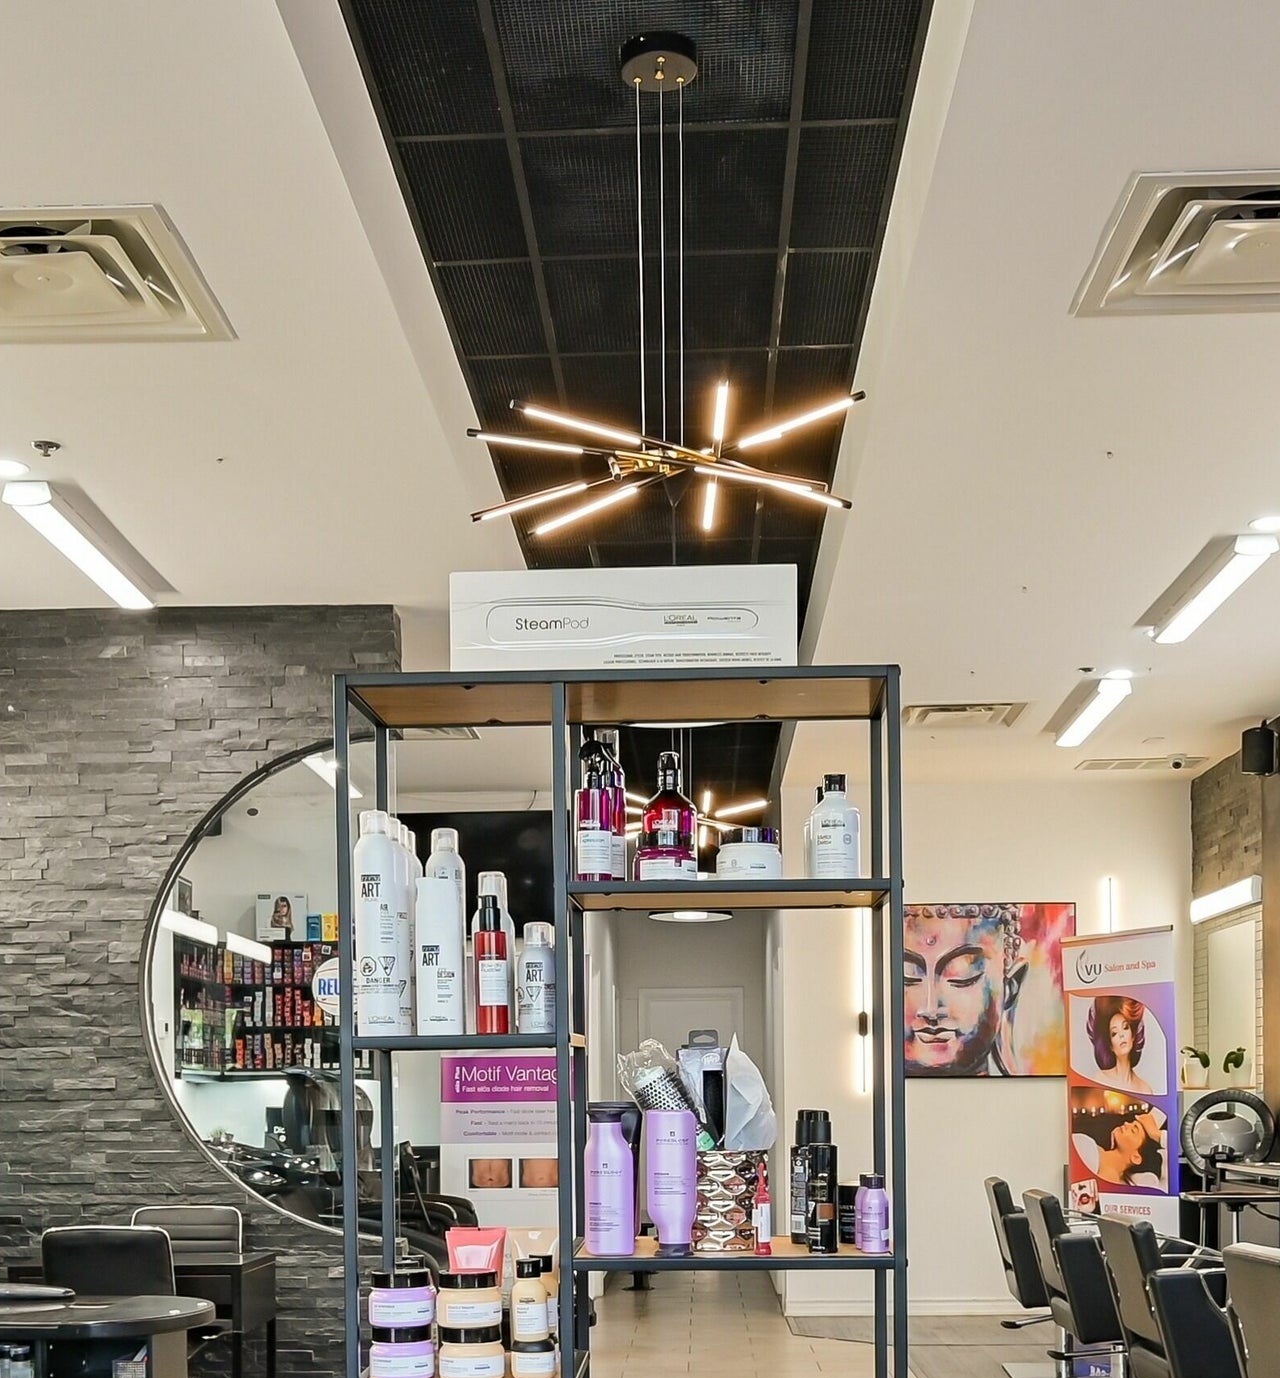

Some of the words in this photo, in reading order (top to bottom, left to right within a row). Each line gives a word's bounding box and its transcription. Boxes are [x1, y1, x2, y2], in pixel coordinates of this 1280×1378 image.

[515, 616, 589, 631] SteamPod
[361, 883, 380, 898] ART
[422, 953, 439, 966] ART
[1085, 963, 1102, 976] VU
[1104, 964, 1125, 972] Salon
[1125, 961, 1139, 970] and
[1141, 961, 1156, 970] Spa
[318, 978, 340, 995] REU
[461, 1066, 501, 1081] Motif
[505, 1066, 557, 1084] Vantag
[1104, 1204, 1119, 1212] OUR
[1120, 1205, 1151, 1215] SERVICES
